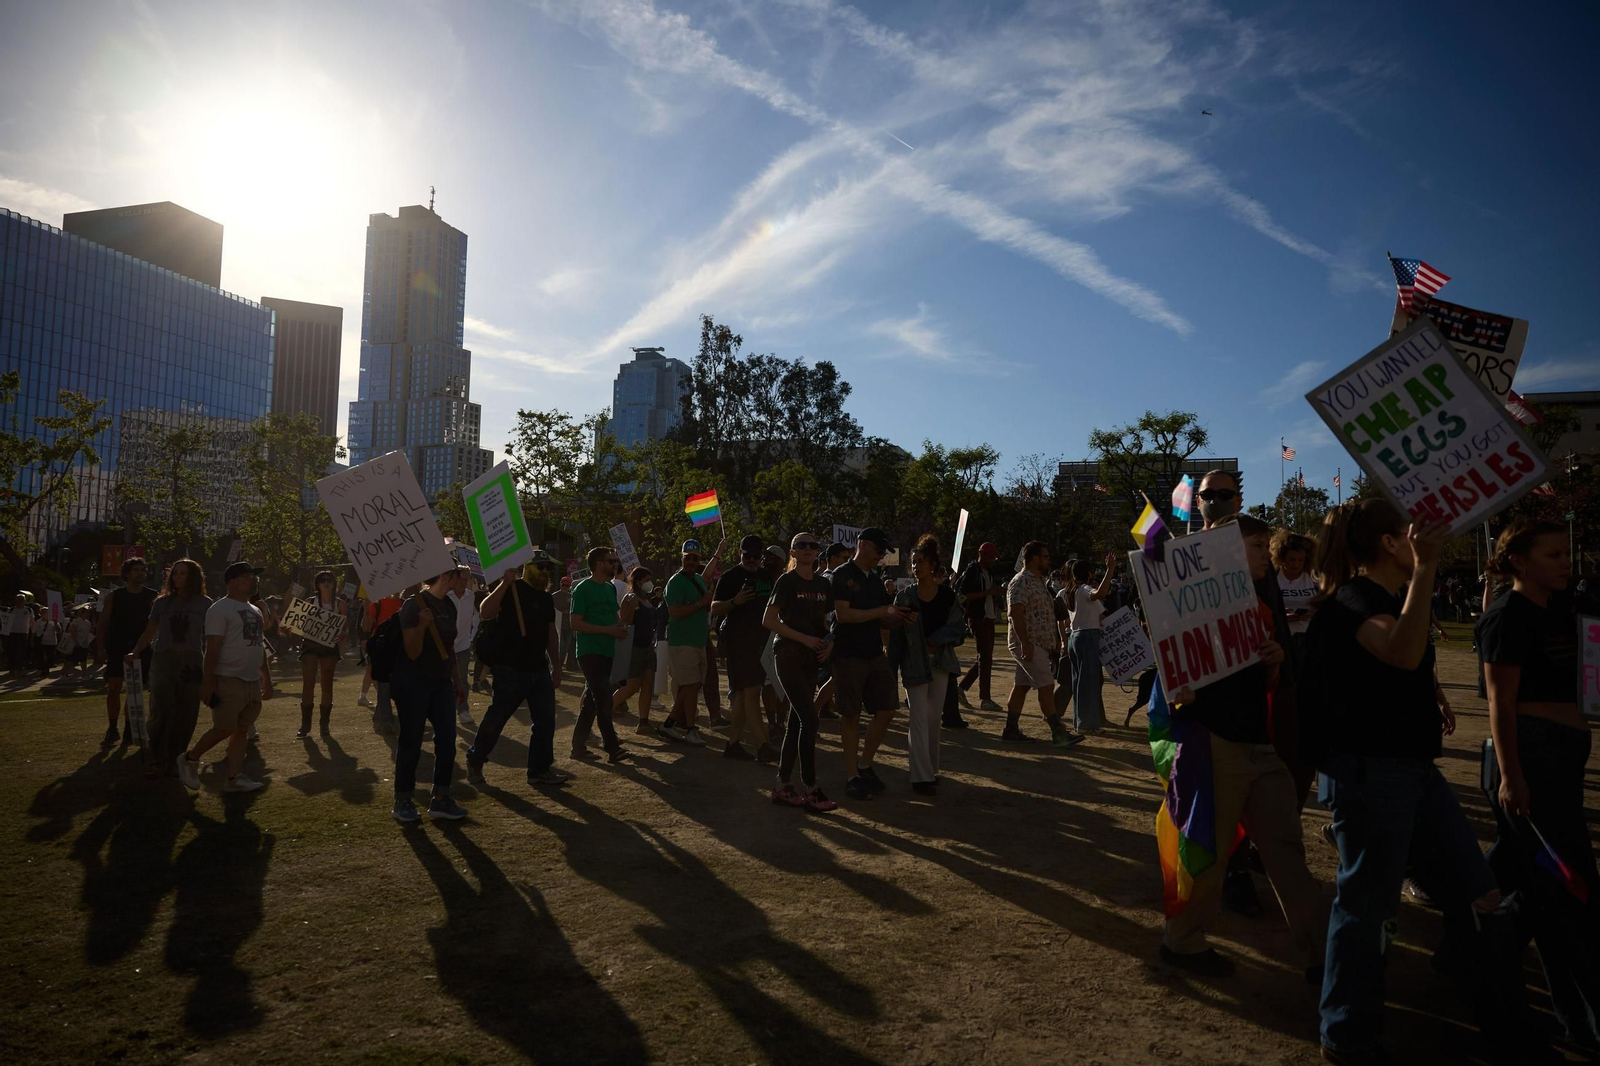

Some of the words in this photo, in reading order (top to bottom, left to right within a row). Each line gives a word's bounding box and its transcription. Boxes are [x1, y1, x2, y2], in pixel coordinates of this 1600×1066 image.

[1426, 301, 1511, 348] EMOVE
[1319, 373, 1369, 417] YOU
[1343, 363, 1455, 453] CHEAP
[1376, 410, 1467, 478] EGGS
[1390, 471, 1425, 499] BUT
[1431, 443, 1472, 474] YOU
[1472, 420, 1508, 451] GOT
[330, 471, 365, 498] THIS
[371, 463, 385, 476] IS
[391, 465, 400, 478] A
[341, 489, 426, 533] MORAL
[350, 518, 425, 567] MOMENT
[838, 528, 860, 545] DUM
[1142, 559, 1170, 595] NO
[1172, 543, 1209, 580] ONE
[1169, 577, 1221, 618] VOTED
[1223, 570, 1250, 603] FOR
[1281, 588, 1316, 597] ESIST
[284, 610, 340, 645] FASCISTS!
[294, 599, 325, 620] FUCK
[325, 612, 345, 628] YOU
[1099, 612, 1134, 639] RSCHE:
[1105, 629, 1121, 642] FAST
[1105, 641, 1146, 669] TESLA:
[1112, 637, 1136, 655] FASTER
[1112, 651, 1146, 680] FASCIST
[1158, 623, 1217, 692] ELON
